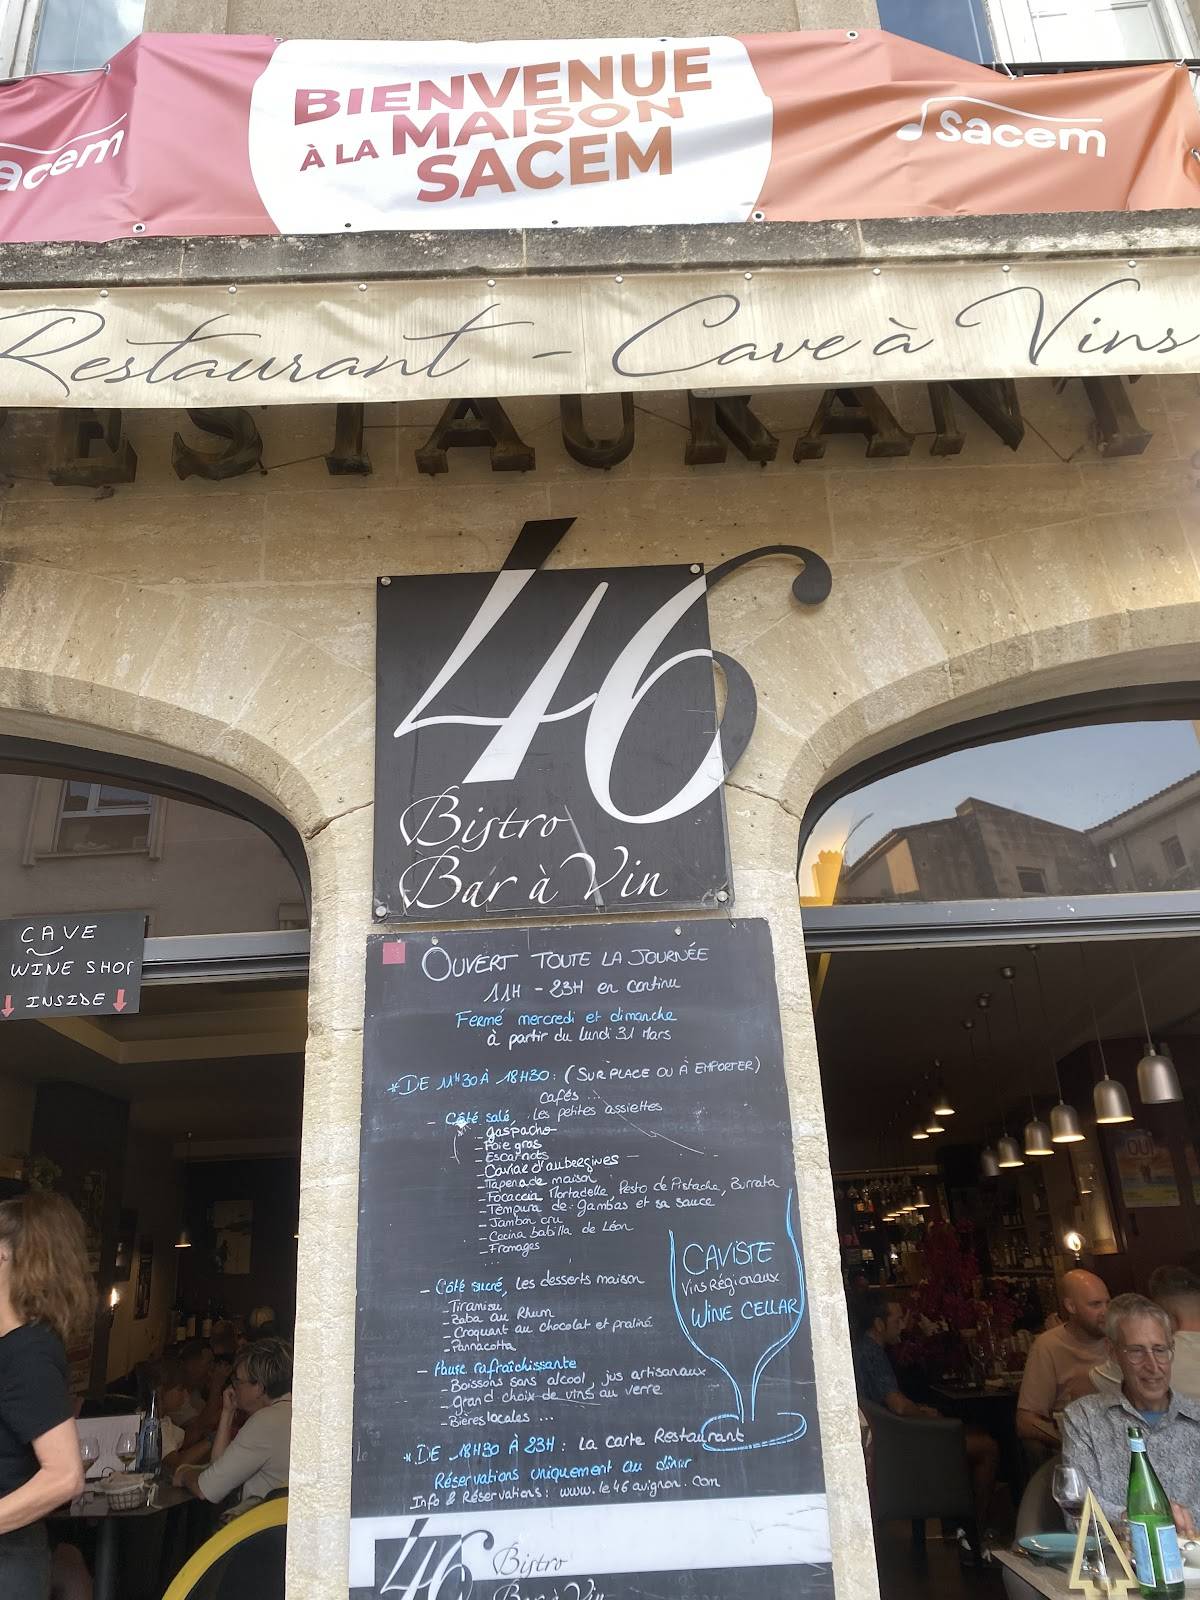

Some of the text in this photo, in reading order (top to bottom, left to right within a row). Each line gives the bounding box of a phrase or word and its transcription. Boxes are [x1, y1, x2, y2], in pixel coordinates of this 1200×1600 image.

[295, 46, 713, 126] BIENVENUE
[300, 96, 684, 172] À LA MAISON
[937, 110, 1107, 157] Sacem
[416, 126, 673, 202] SACEM
[0, 303, 535, 398] Restaurant
[611, 295, 862, 378] Cave
[872, 317, 934, 354] à
[954, 278, 1200, 366] Vins
[394, 517, 832, 824] 46
[400, 785, 573, 852] Bistro
[399, 845, 669, 908] Bar à Vin
[20, 925, 98, 943] CAVE
[11, 961, 74, 977] WINE
[422, 941, 710, 981] OUVERT TOUTE LA JOURNÉE
[25, 993, 106, 1008] INSIDE
[483, 983, 521, 1003] 11H
[549, 979, 583, 998] 23H
[597, 981, 619, 995] en
[455, 1006, 678, 1029] Fermé mercredi et dimanche
[487, 1030, 500, 1047] à
[509, 1028, 549, 1050] partir
[554, 1027, 573, 1042] du
[641, 1026, 672, 1041] Mars
[610, 1067, 650, 1080] PLACE
[656, 1067, 674, 1078] OU
[445, 1112, 479, 1127] Côté
[557, 1104, 597, 1123] petites
[604, 1102, 664, 1115] assiettes
[484, 1139, 543, 1155] Foie gras
[484, 1174, 598, 1192] Tapenade maison
[486, 1190, 543, 1203] Focaccia
[619, 1180, 648, 1194] Pesto
[653, 1176, 668, 1191] de
[486, 1203, 542, 1217] Tempura
[551, 1199, 567, 1211] de
[636, 1197, 650, 1209] et
[655, 1200, 670, 1209] sa
[676, 1197, 716, 1207] sauce
[489, 1216, 563, 1228] Jambon cru
[581, 1221, 596, 1234] de
[602, 1220, 634, 1232] Léon
[488, 1242, 540, 1257] Fromages
[435, 1279, 466, 1295] Côté
[540, 1269, 592, 1287] desserts
[596, 1273, 646, 1285] maison
[448, 1299, 503, 1313] Tiramisu
[489, 1312, 510, 1322] au
[517, 1306, 556, 1321] Rhum
[741, 1298, 801, 1320] CELLAR
[453, 1316, 655, 1342] Croquant au chocolat et praliné
[451, 1378, 504, 1393] Boissons
[510, 1375, 538, 1388] sans
[601, 1370, 624, 1386] jus
[630, 1366, 708, 1380] artisanaux
[502, 1388, 536, 1403] choix
[542, 1388, 558, 1401] de
[599, 1389, 619, 1399] au
[625, 1383, 663, 1396] verre
[449, 1413, 486, 1428] Bières
[487, 1410, 531, 1424] locales
[508, 1434, 519, 1454] À
[606, 1433, 646, 1449] carte
[654, 1427, 745, 1443] Restaurant
[434, 1468, 520, 1489] Réservations
[531, 1460, 613, 1483] uniquement
[622, 1461, 643, 1473] au
[410, 1493, 440, 1510] Info
[492, 1541, 568, 1579] Bistro
